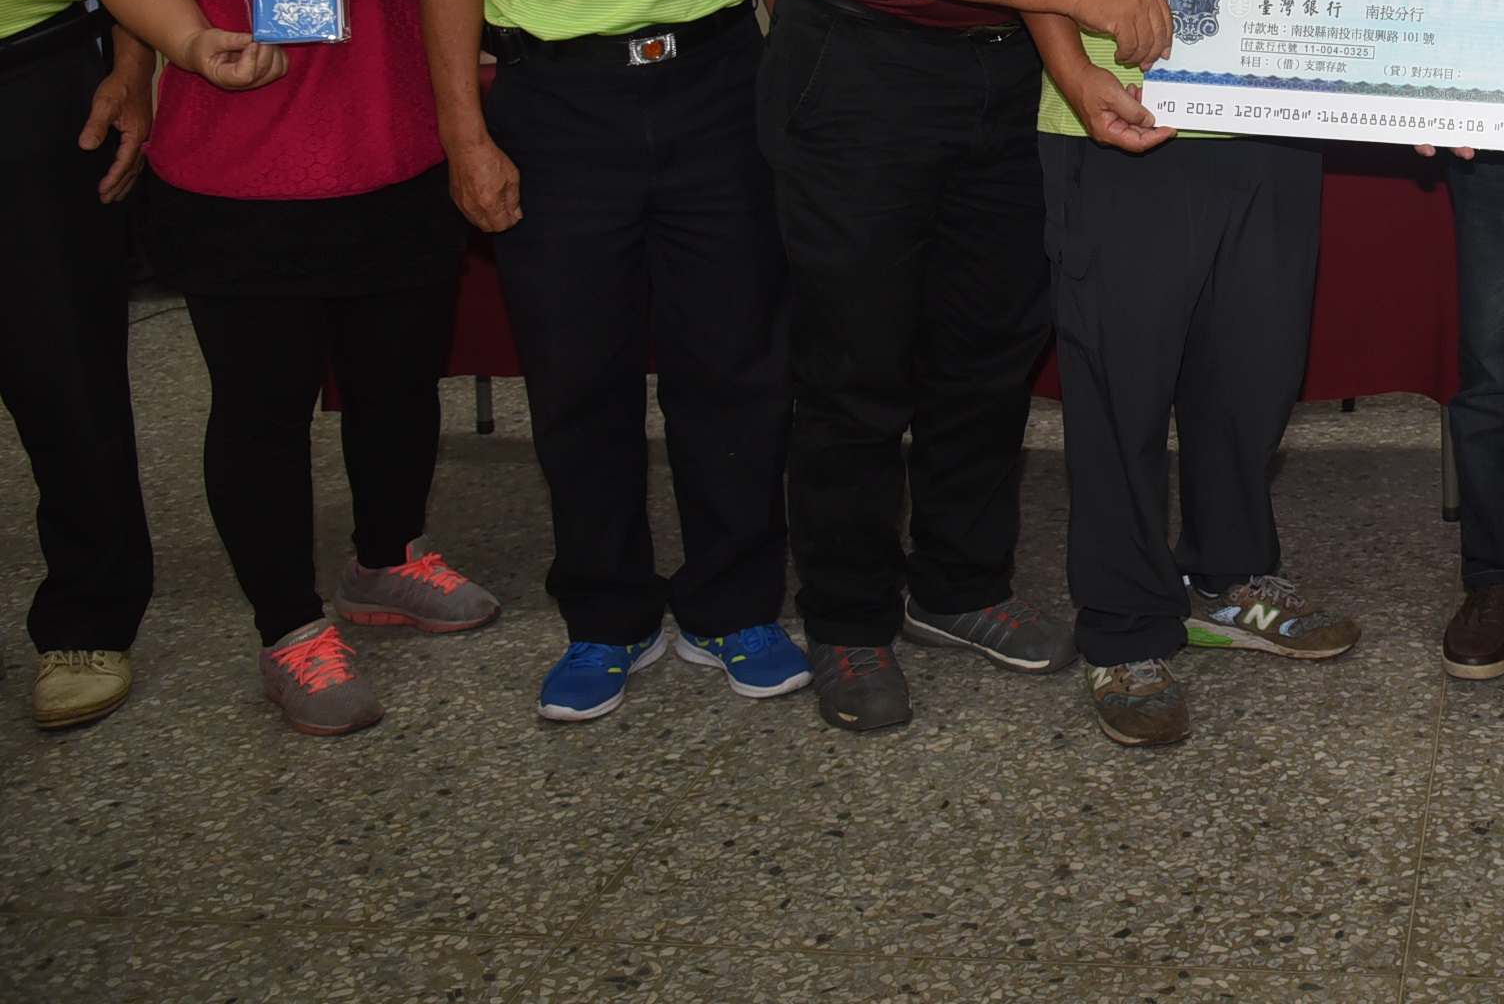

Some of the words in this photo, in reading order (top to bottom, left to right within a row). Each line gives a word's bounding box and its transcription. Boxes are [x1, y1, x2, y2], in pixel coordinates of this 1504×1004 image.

[1365, 4, 1425, 23] 南投分行
[1402, 31, 1419, 43] 101
[1244, 40, 1298, 55] 付款行代號
[1304, 44, 1369, 57] 11-004-0325
[1417, 89, 1454, 100] BANK
[1186, 102, 1224, 116] 2012
